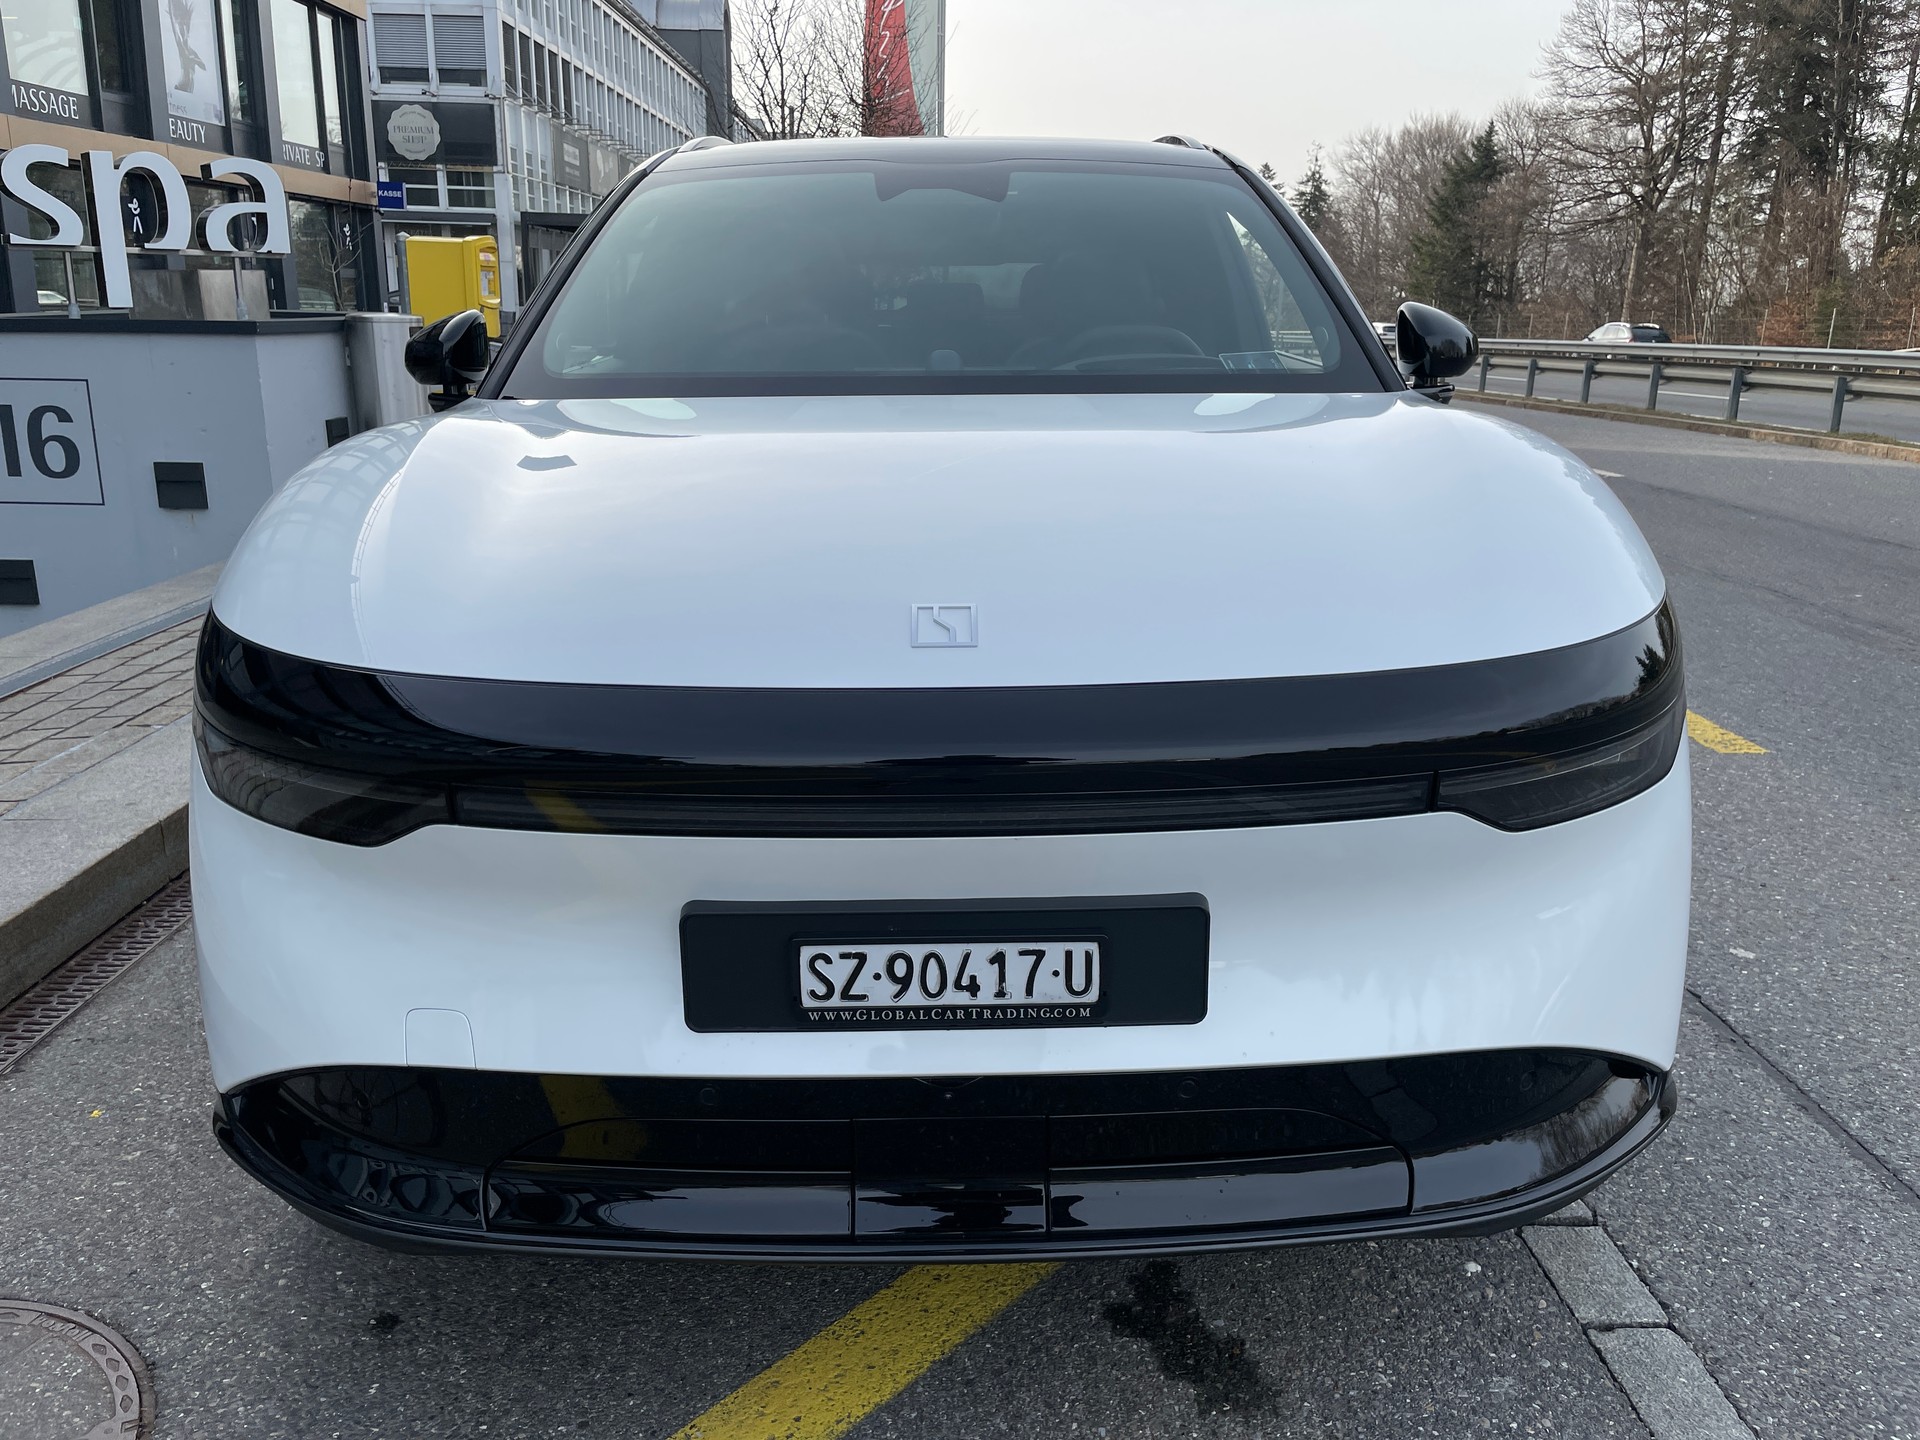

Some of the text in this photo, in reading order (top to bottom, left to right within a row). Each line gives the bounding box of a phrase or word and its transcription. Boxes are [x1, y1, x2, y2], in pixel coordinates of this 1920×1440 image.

[168, 118, 206, 144] EAUTY
[393, 125, 434, 135] PREMIUM
[378, 189, 402, 198] KASSE
[0, 143, 291, 308] spa
[0, 404, 81, 480] 16
